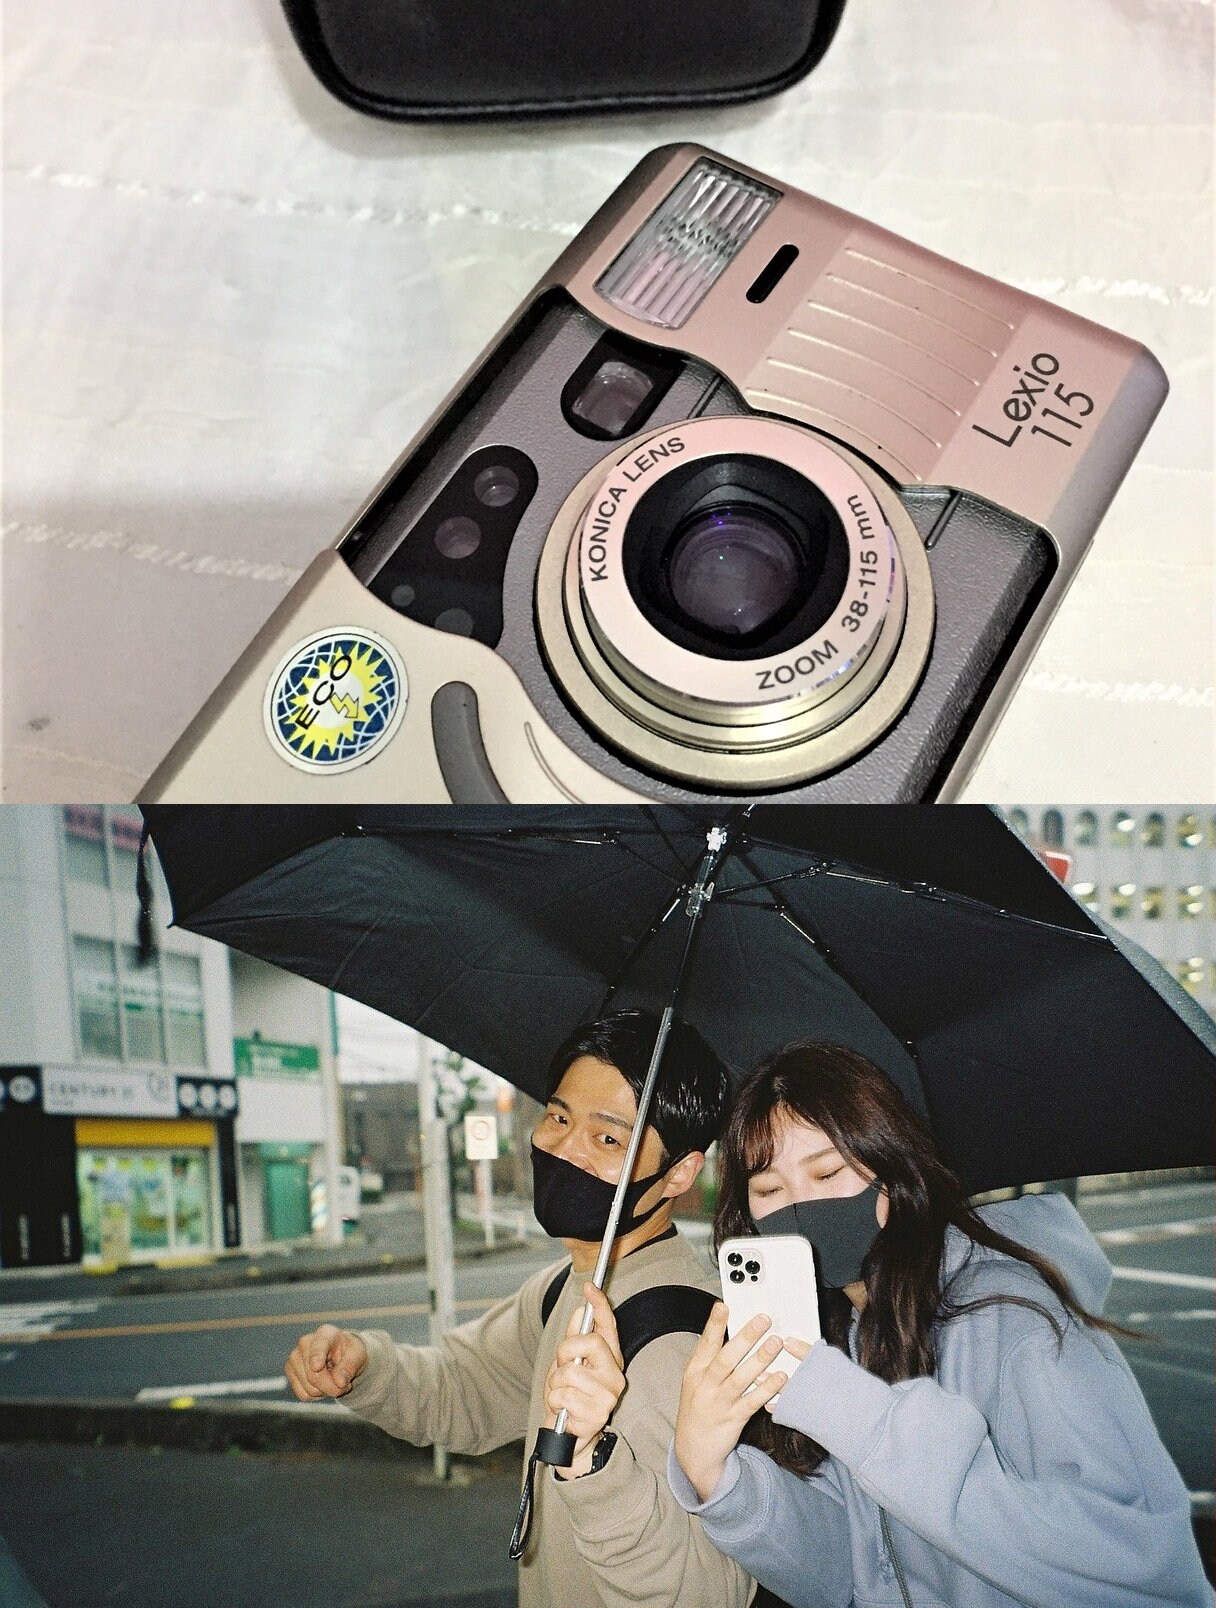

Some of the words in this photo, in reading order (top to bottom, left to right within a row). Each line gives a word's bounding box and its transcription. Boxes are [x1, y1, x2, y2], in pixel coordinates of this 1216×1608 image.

[972, 352, 1060, 448] Lexio
[1031, 382, 1094, 448] 115
[588, 485, 627, 582] KONICA
[622, 436, 686, 482] LENS
[847, 494, 875, 540] mm
[841, 550, 878, 633] 38-115
[294, 654, 352, 731] ECO
[755, 639, 839, 690] ZOOM
